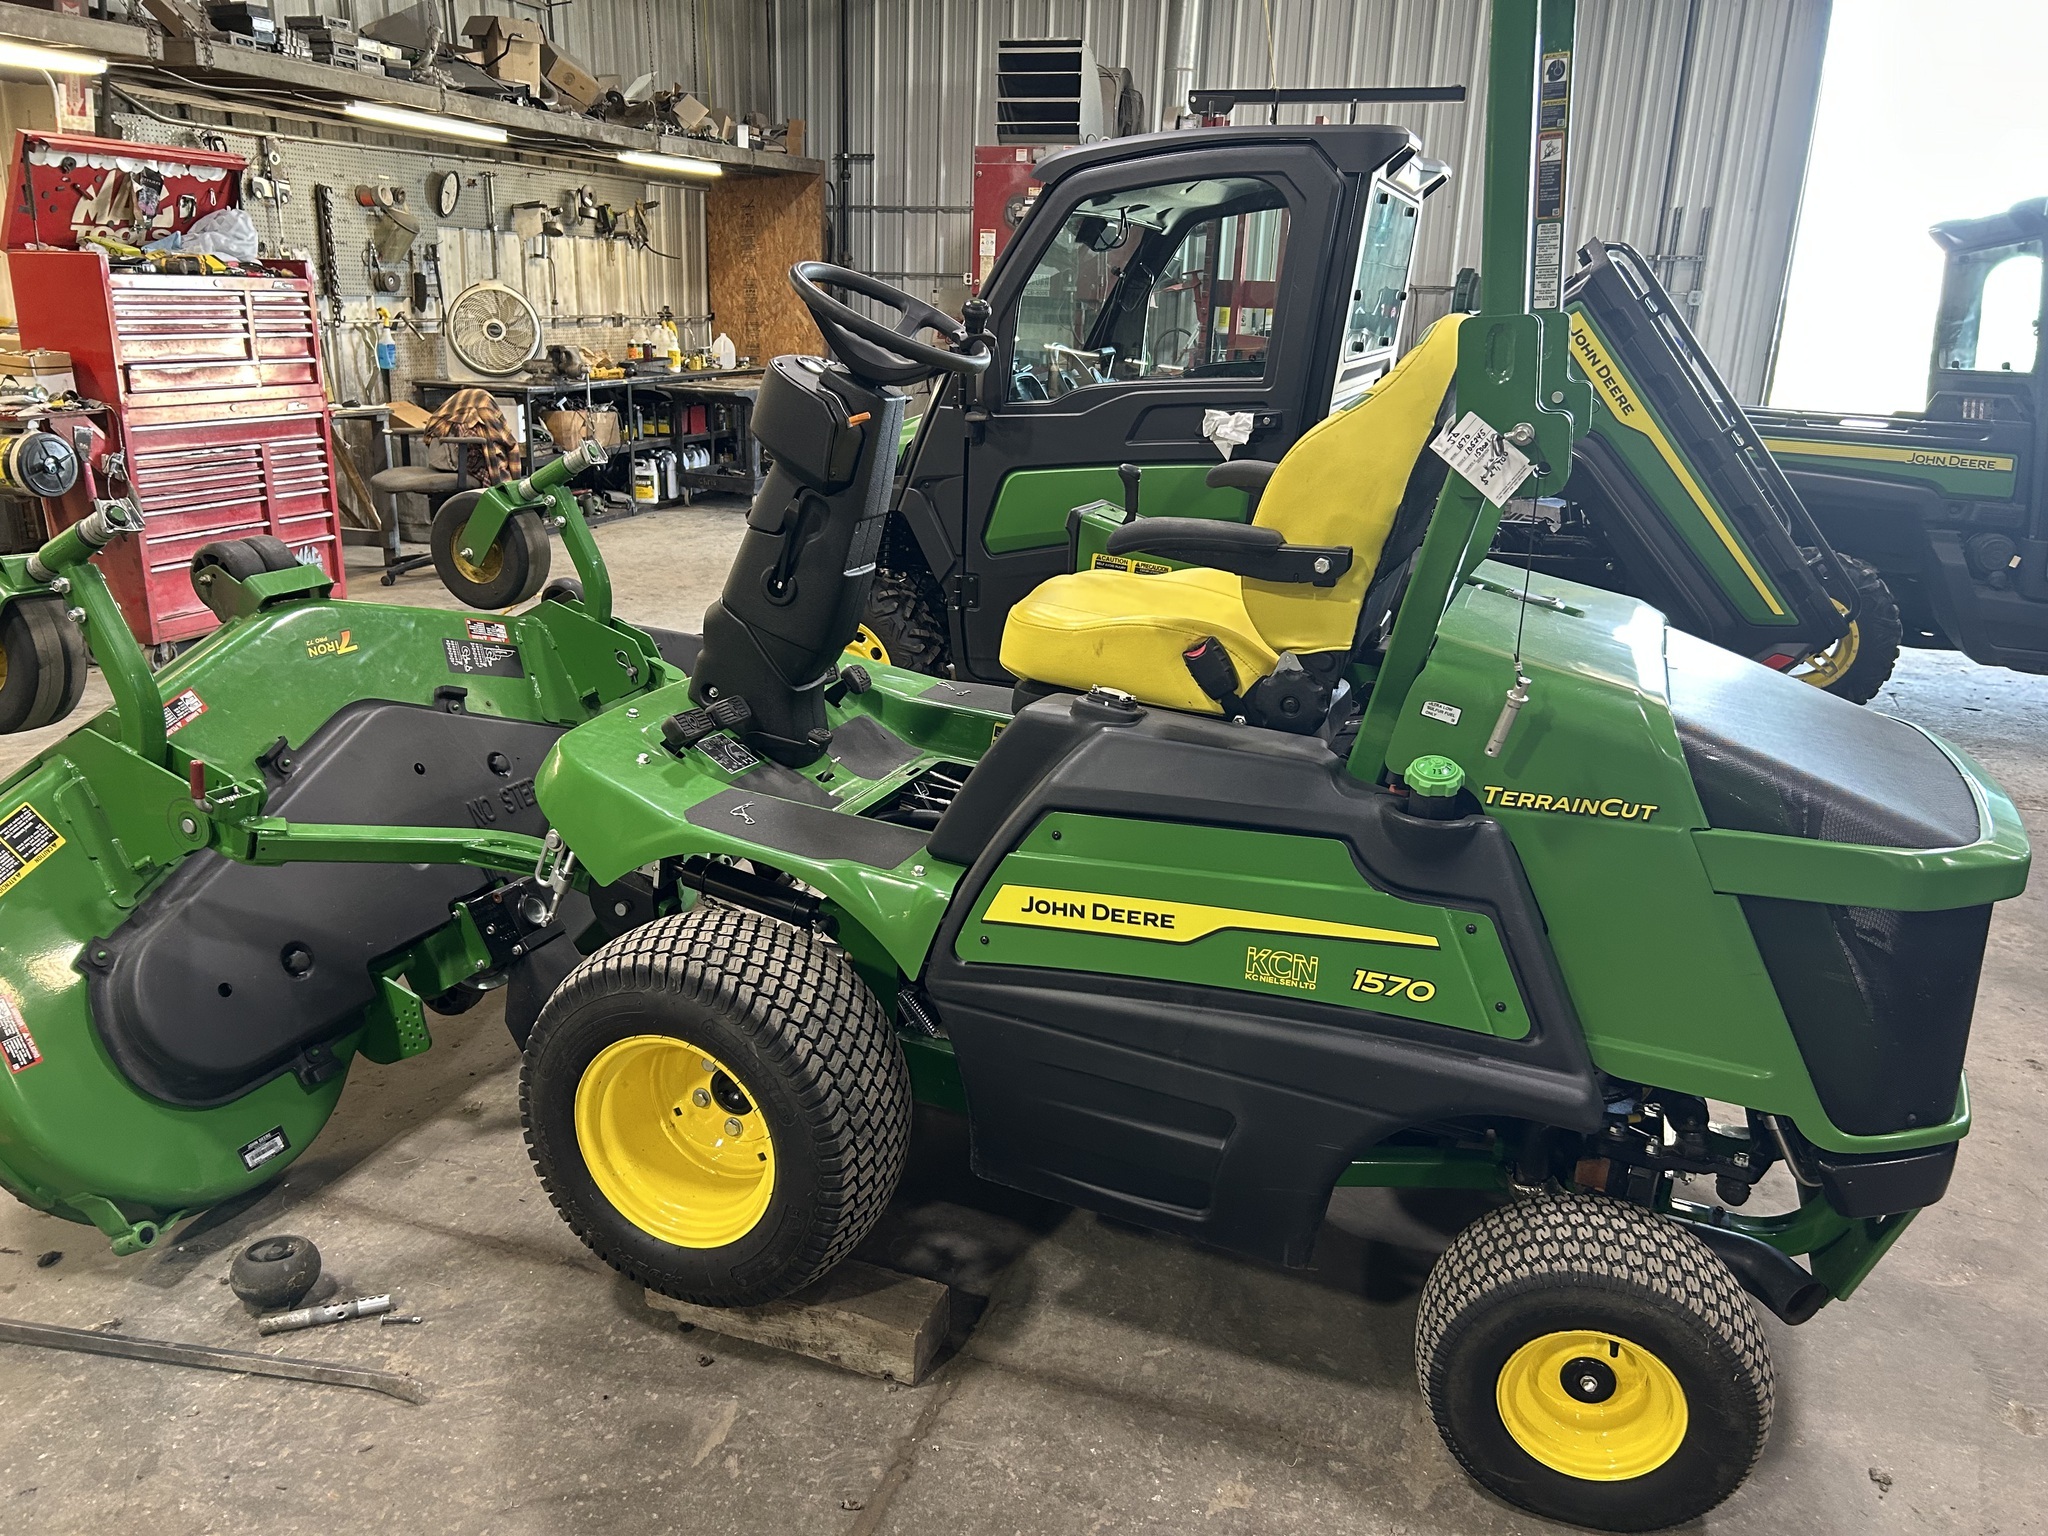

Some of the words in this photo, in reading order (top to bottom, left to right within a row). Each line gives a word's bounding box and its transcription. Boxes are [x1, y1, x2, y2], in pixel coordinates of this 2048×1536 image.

[1571, 328, 1602, 367] JOHN
[1596, 364, 1635, 417] DEERE
[1457, 434, 1471, 451] 1570
[1907, 452, 1946, 466] JOHN
[1949, 455, 1997, 470] DEERE
[1101, 555, 1128, 566] CAUTION
[466, 796, 496, 828] NO
[34, 845, 54, 864] CAUTION
[1021, 896, 1085, 919] JOHN
[1092, 902, 1175, 930] DEERE
[1245, 946, 1319, 984] KCN
[1245, 973, 1258, 982] KC
[1299, 981, 1316, 991] LTD
[1352, 968, 1436, 1002] 1570
